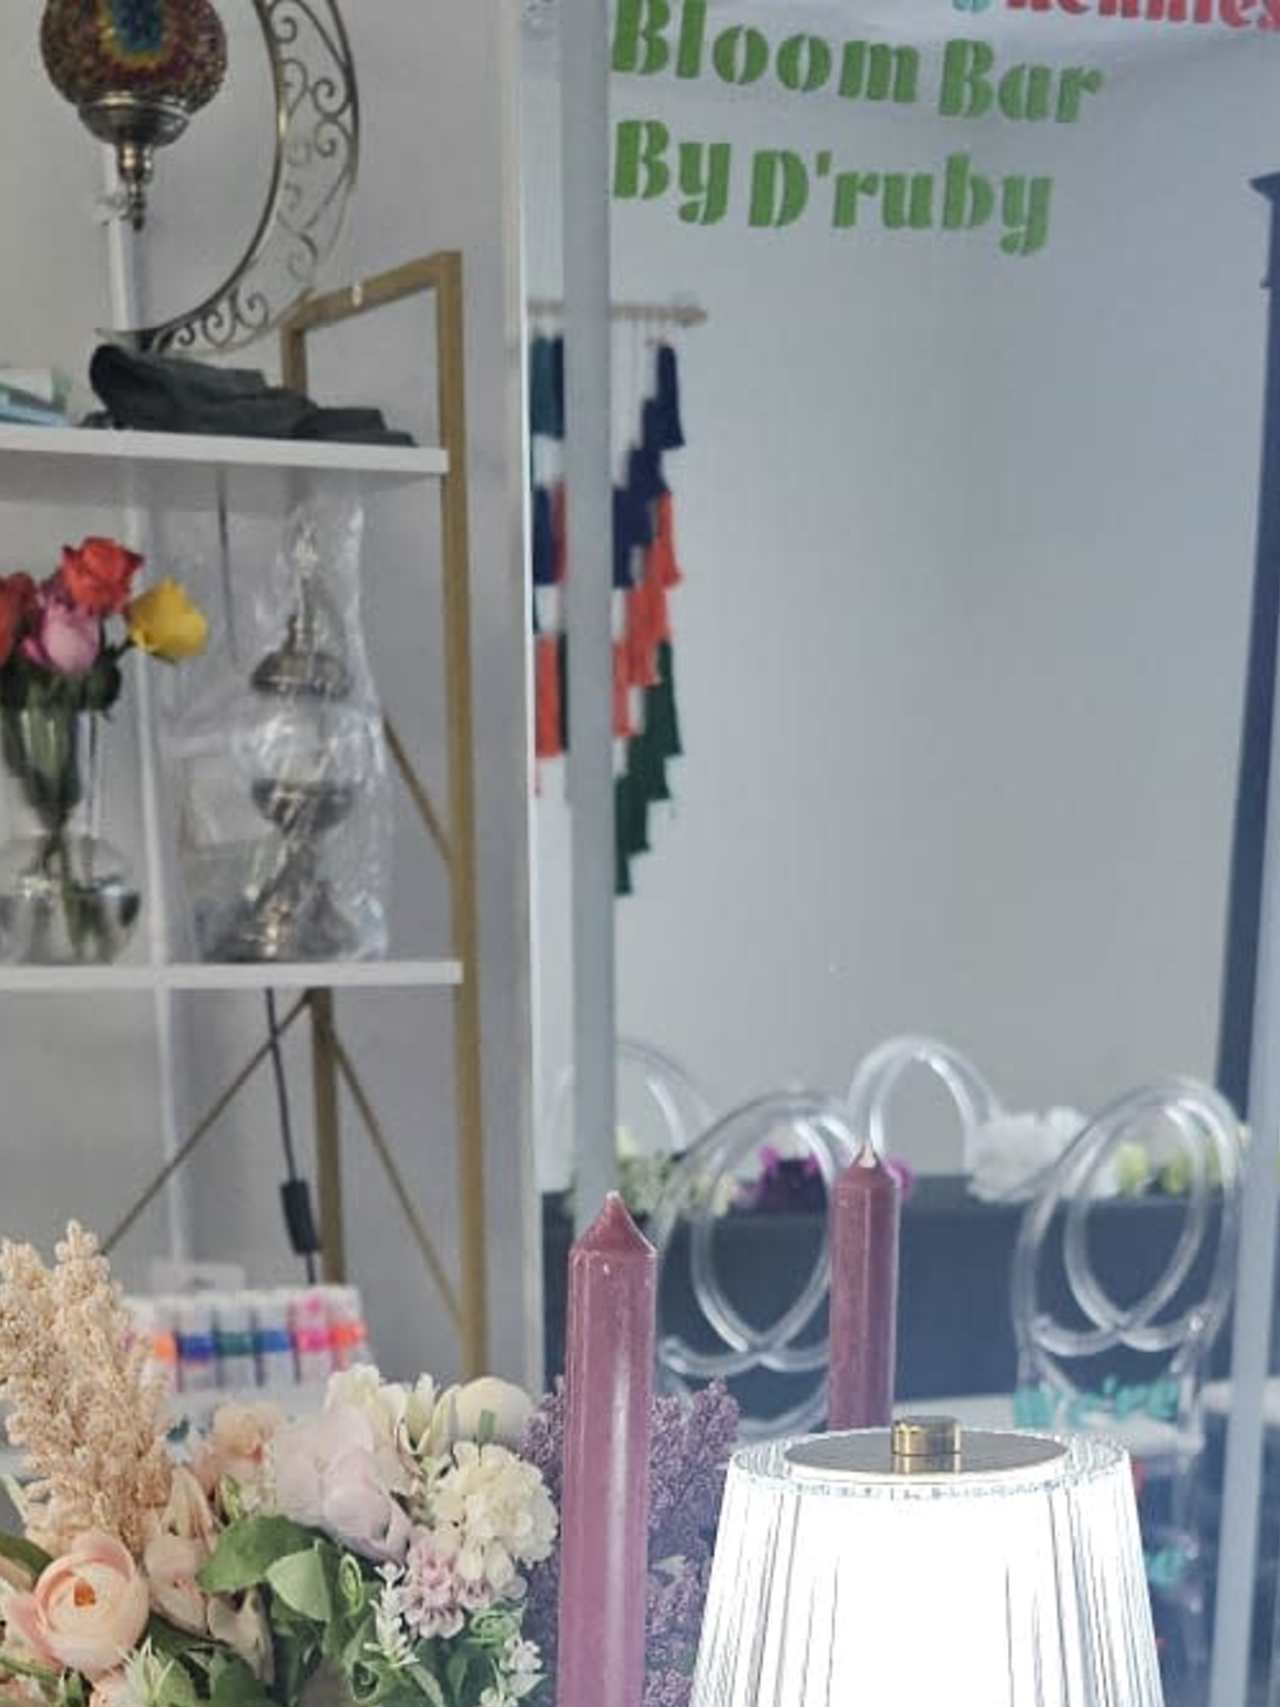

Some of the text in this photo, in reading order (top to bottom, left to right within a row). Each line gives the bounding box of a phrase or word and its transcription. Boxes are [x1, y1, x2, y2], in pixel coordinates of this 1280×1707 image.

[611, 0, 1103, 123] Bloom Bar
[613, 119, 1055, 257] By D'ruby
